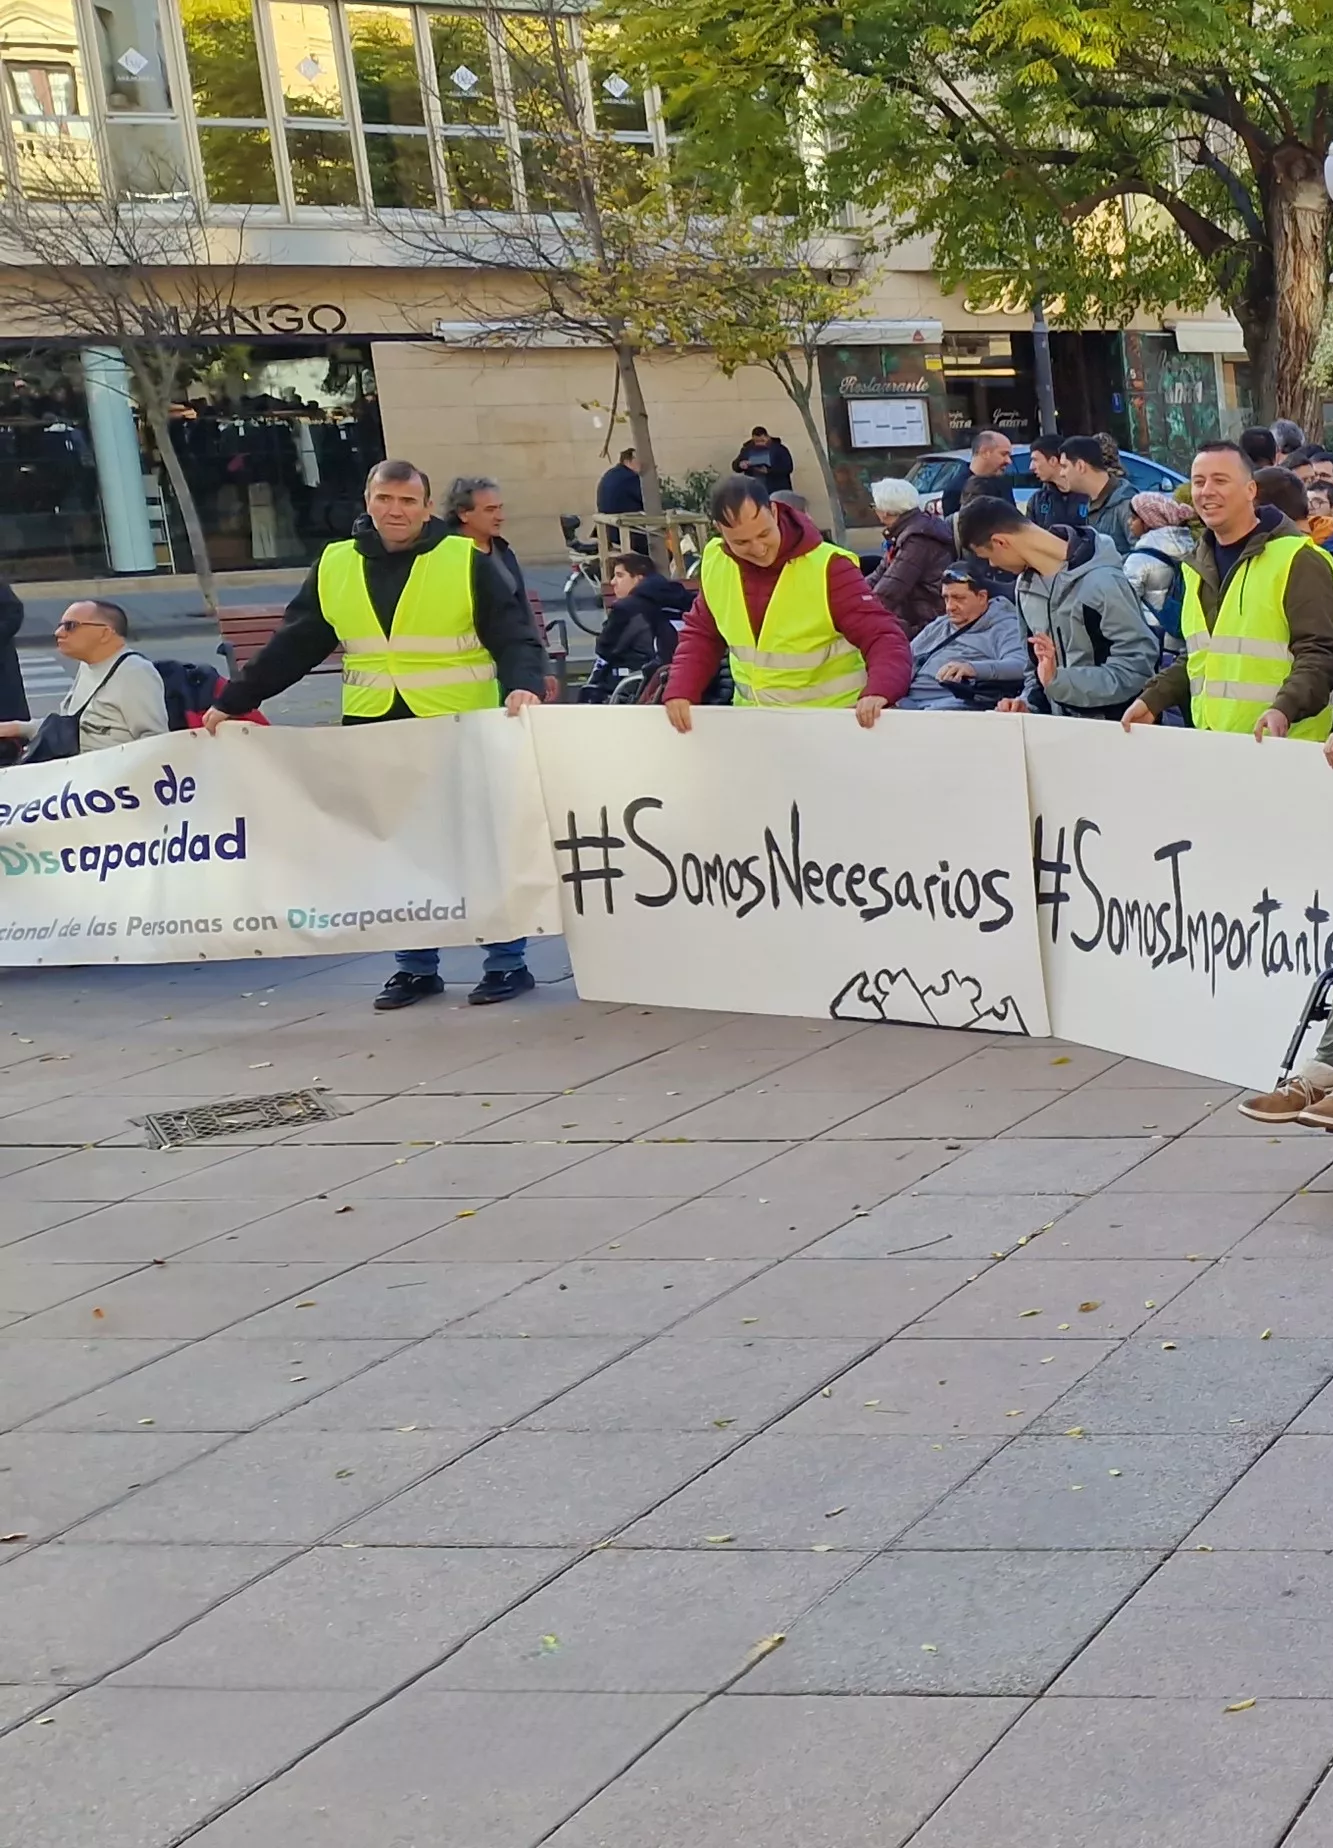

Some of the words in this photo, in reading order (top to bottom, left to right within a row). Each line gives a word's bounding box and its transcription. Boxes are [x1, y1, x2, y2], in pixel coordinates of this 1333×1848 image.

[140, 304, 347, 334] MANGO
[839, 376, 930, 393] Restaurante
[154, 764, 196, 806] de
[0, 816, 247, 882] Discapacidad
[554, 797, 1015, 932] #SomosNecesarios
[57, 916, 81, 937] de
[86, 915, 117, 936] las
[126, 916, 223, 936] Personas
[233, 914, 278, 932] con
[287, 897, 467, 931] Discapacidad
